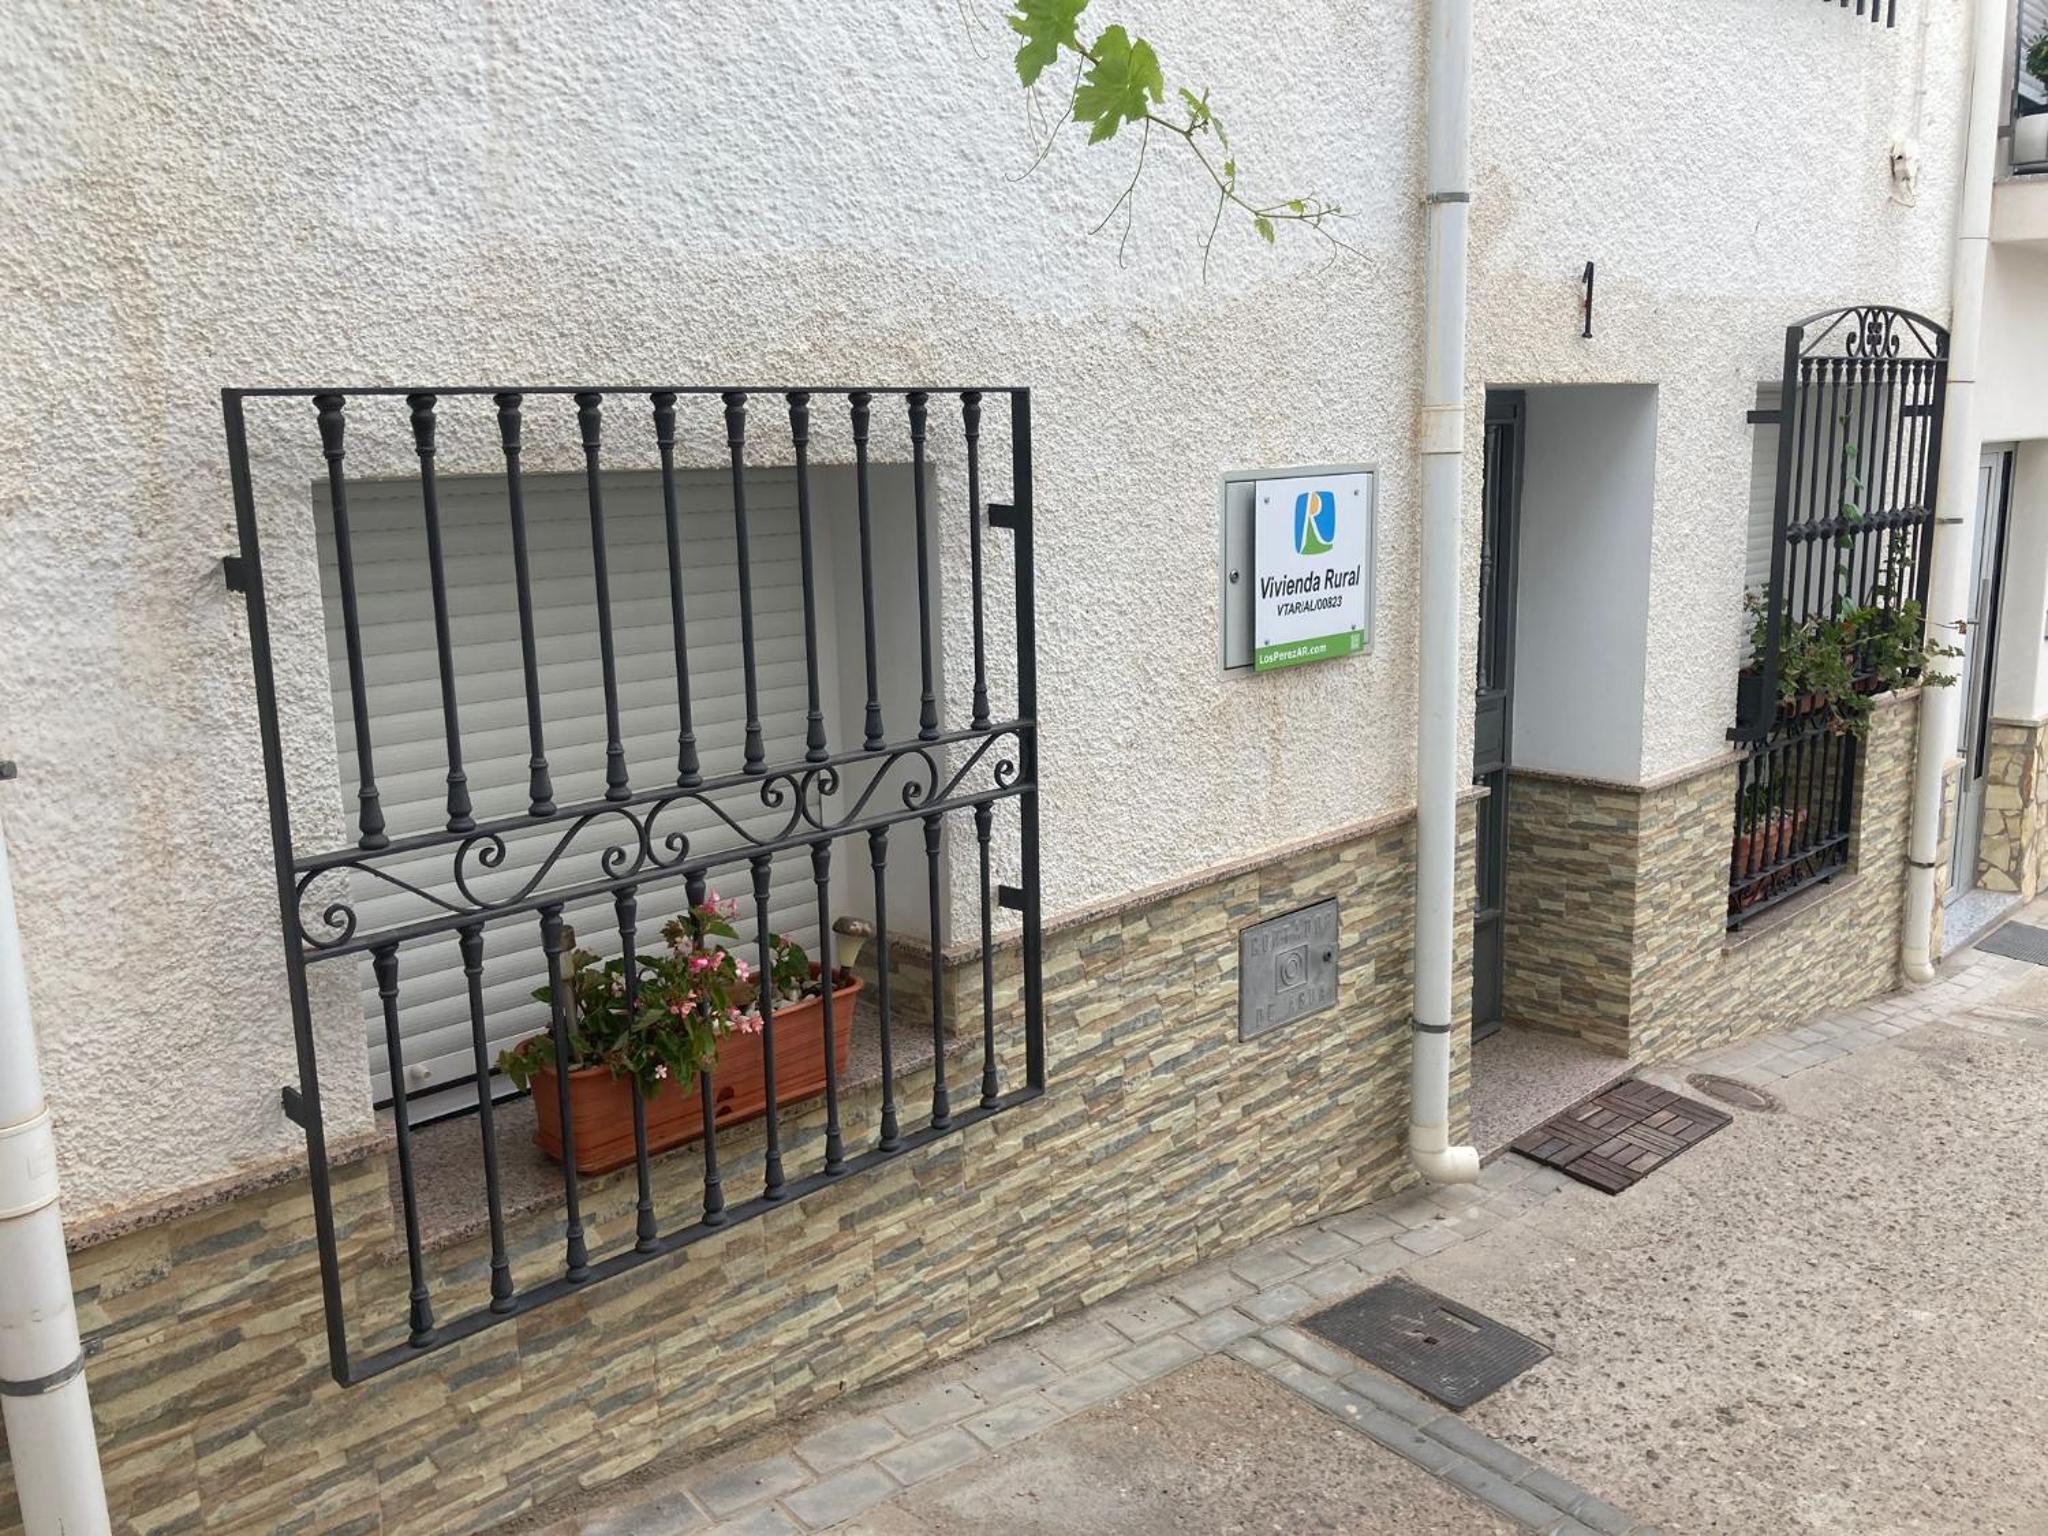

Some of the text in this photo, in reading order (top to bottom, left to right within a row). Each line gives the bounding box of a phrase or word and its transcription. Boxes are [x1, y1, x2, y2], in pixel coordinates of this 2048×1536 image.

[1261, 564, 1361, 599] Vivienda Rural
[1259, 644, 1327, 664] LosPerezAR.com
